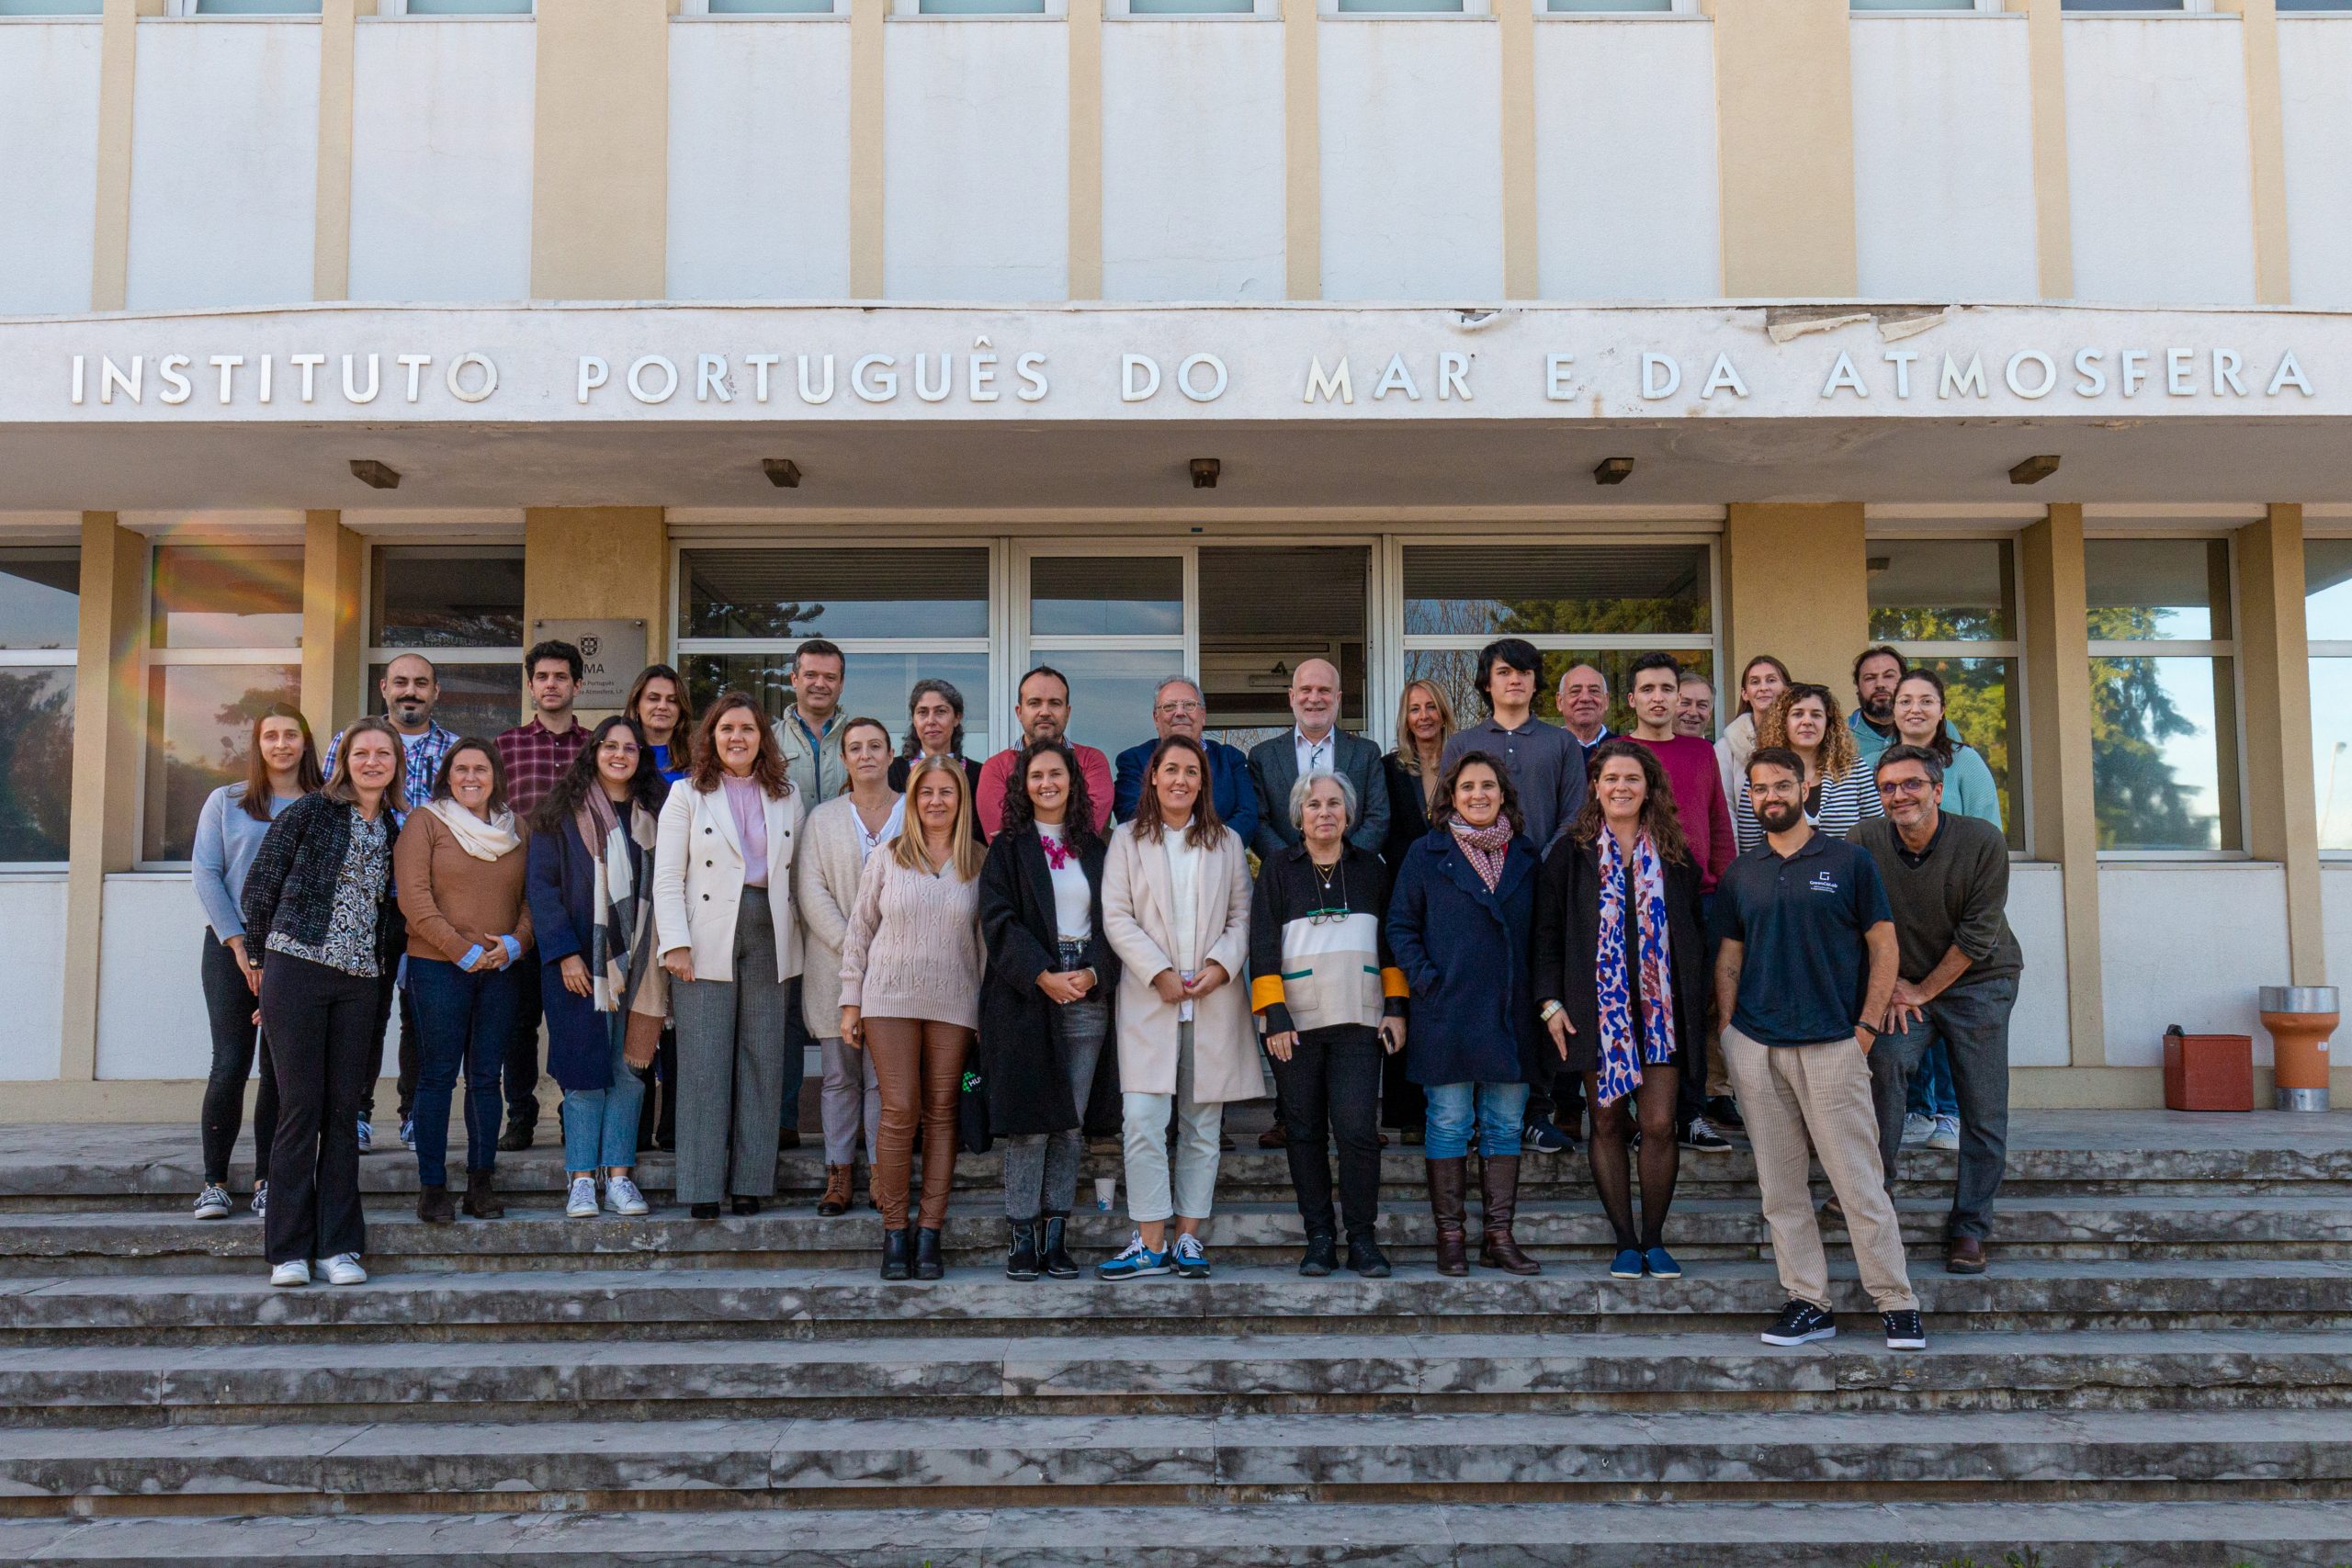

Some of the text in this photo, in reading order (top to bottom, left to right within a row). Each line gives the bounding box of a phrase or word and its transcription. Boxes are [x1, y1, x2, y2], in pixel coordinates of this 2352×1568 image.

[71, 334, 2316, 405] INSTITUTO PORTUGUÊS DO MAR E DA ATMOSFERA
[583, 663, 605, 674] MA
